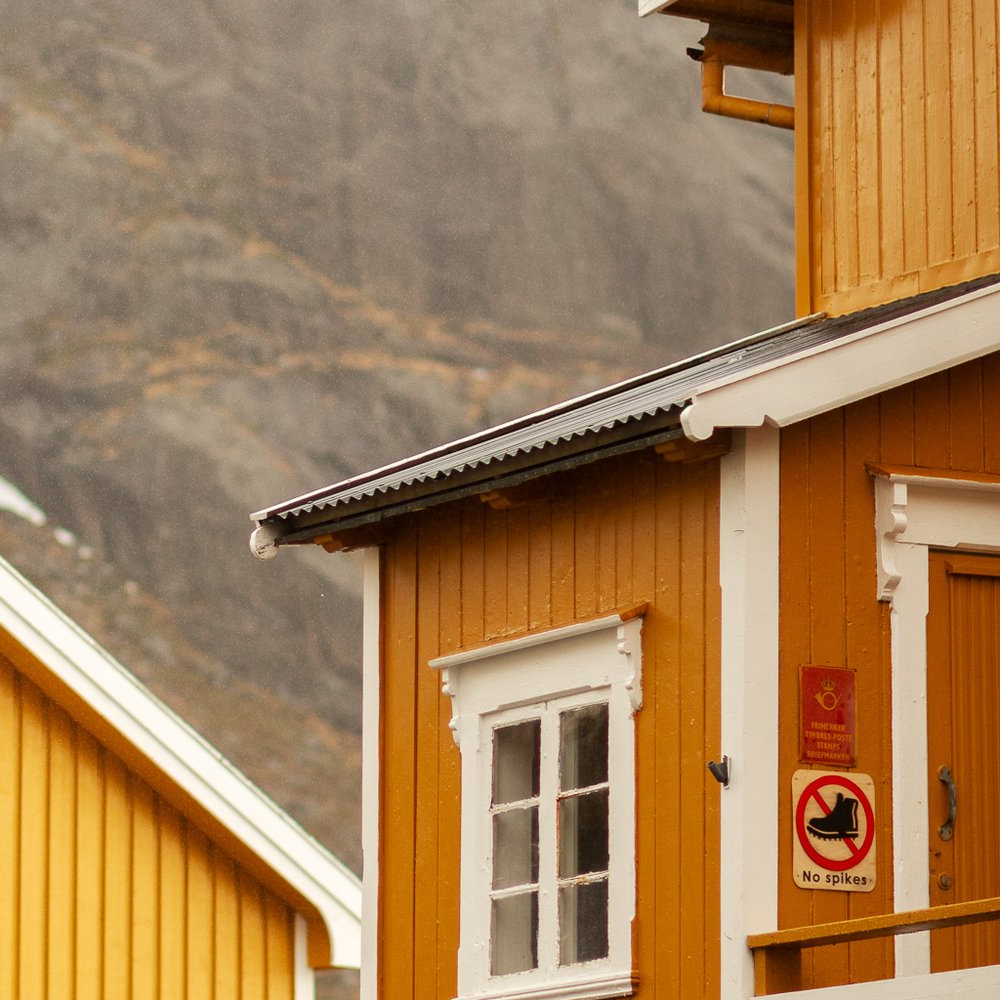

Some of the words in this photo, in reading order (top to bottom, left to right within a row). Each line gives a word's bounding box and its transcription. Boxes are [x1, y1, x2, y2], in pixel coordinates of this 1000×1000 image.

[811, 721, 846, 731] FRIMERKER
[816, 741, 841, 750] STAMPS
[806, 750, 850, 760] BRIEFMARKEN
[802, 870, 821, 882] No
[825, 872, 867, 886] spikes
